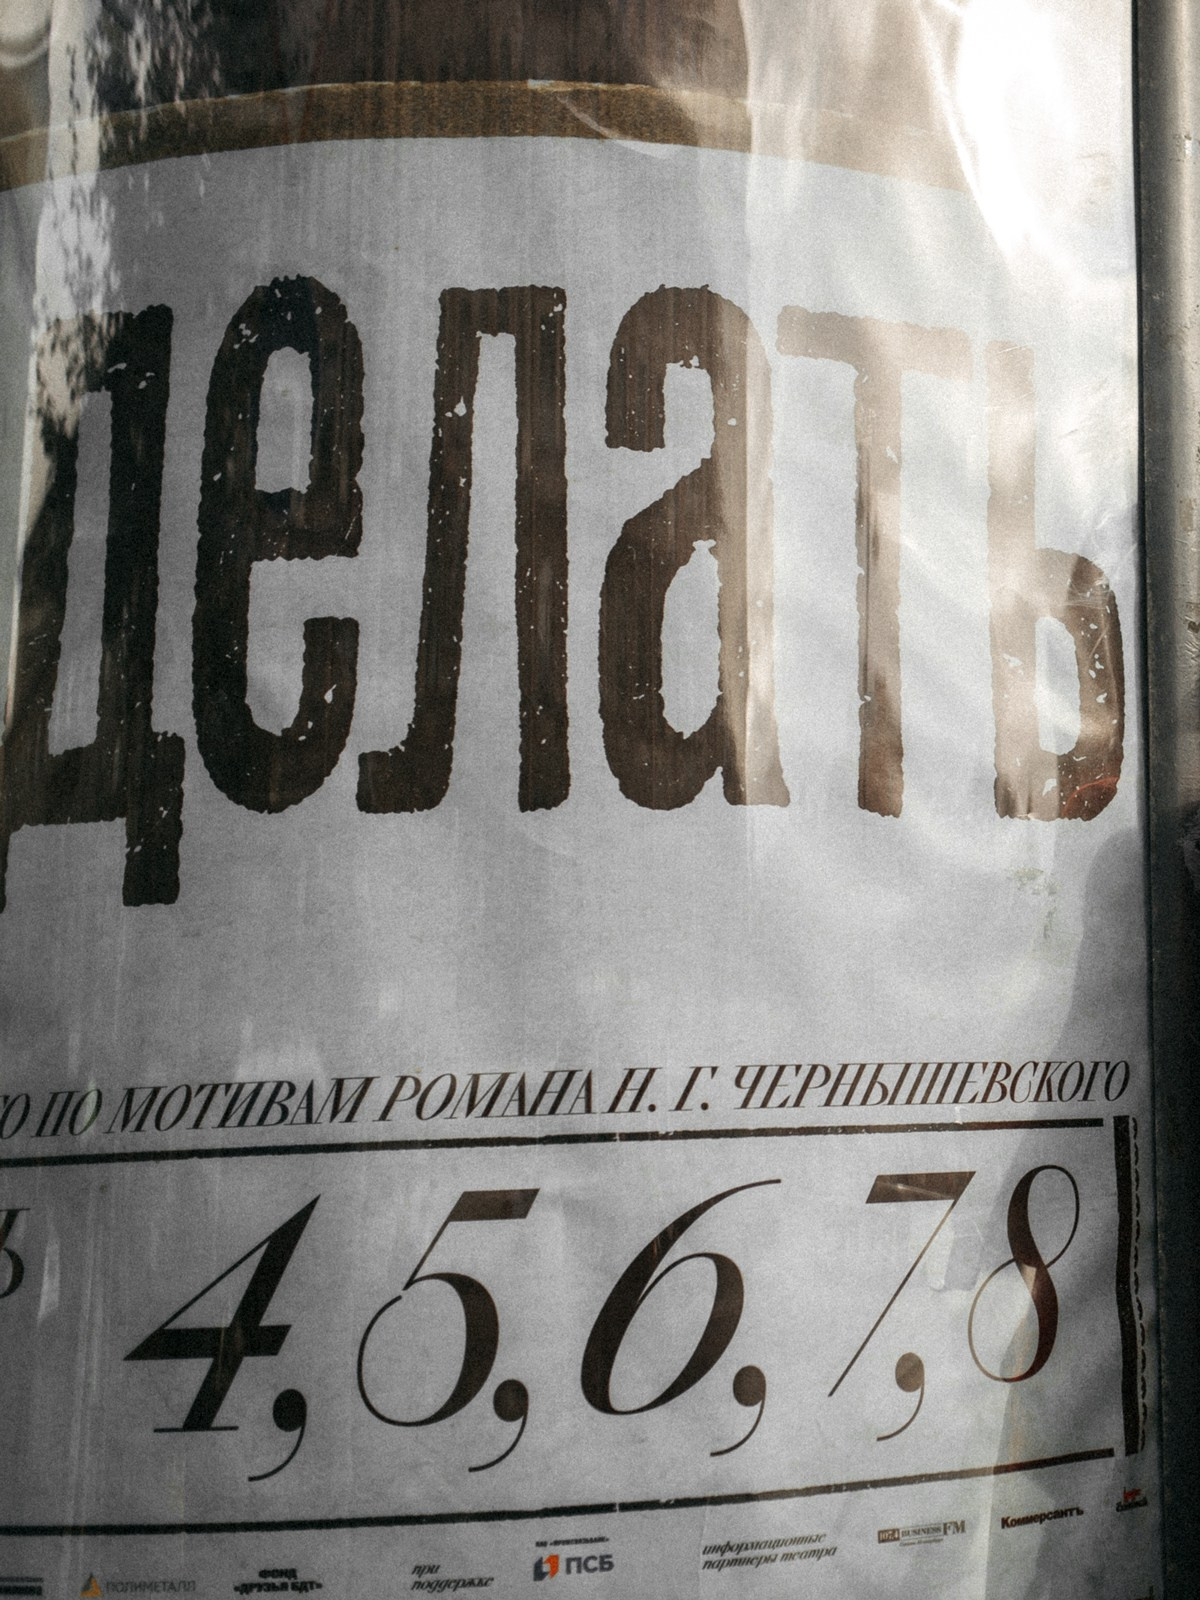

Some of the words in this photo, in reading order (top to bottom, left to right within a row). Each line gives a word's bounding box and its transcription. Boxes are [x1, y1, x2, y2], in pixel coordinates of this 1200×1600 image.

[31, 1089, 103, 1138] ПО
[104, 1076, 381, 1135] МОТИВАМ
[372, 1069, 597, 1122] РОМАНА
[733, 1059, 1130, 1110] ЧЕРНЫШЕВСКОГО
[943, 1520, 966, 1535] FM
[702, 1533, 826, 1557] информационные
[780, 1546, 837, 1562] театра
[411, 1564, 440, 1578] при
[565, 1554, 614, 1575] ПСБ
[411, 1577, 494, 1593] поддержке
